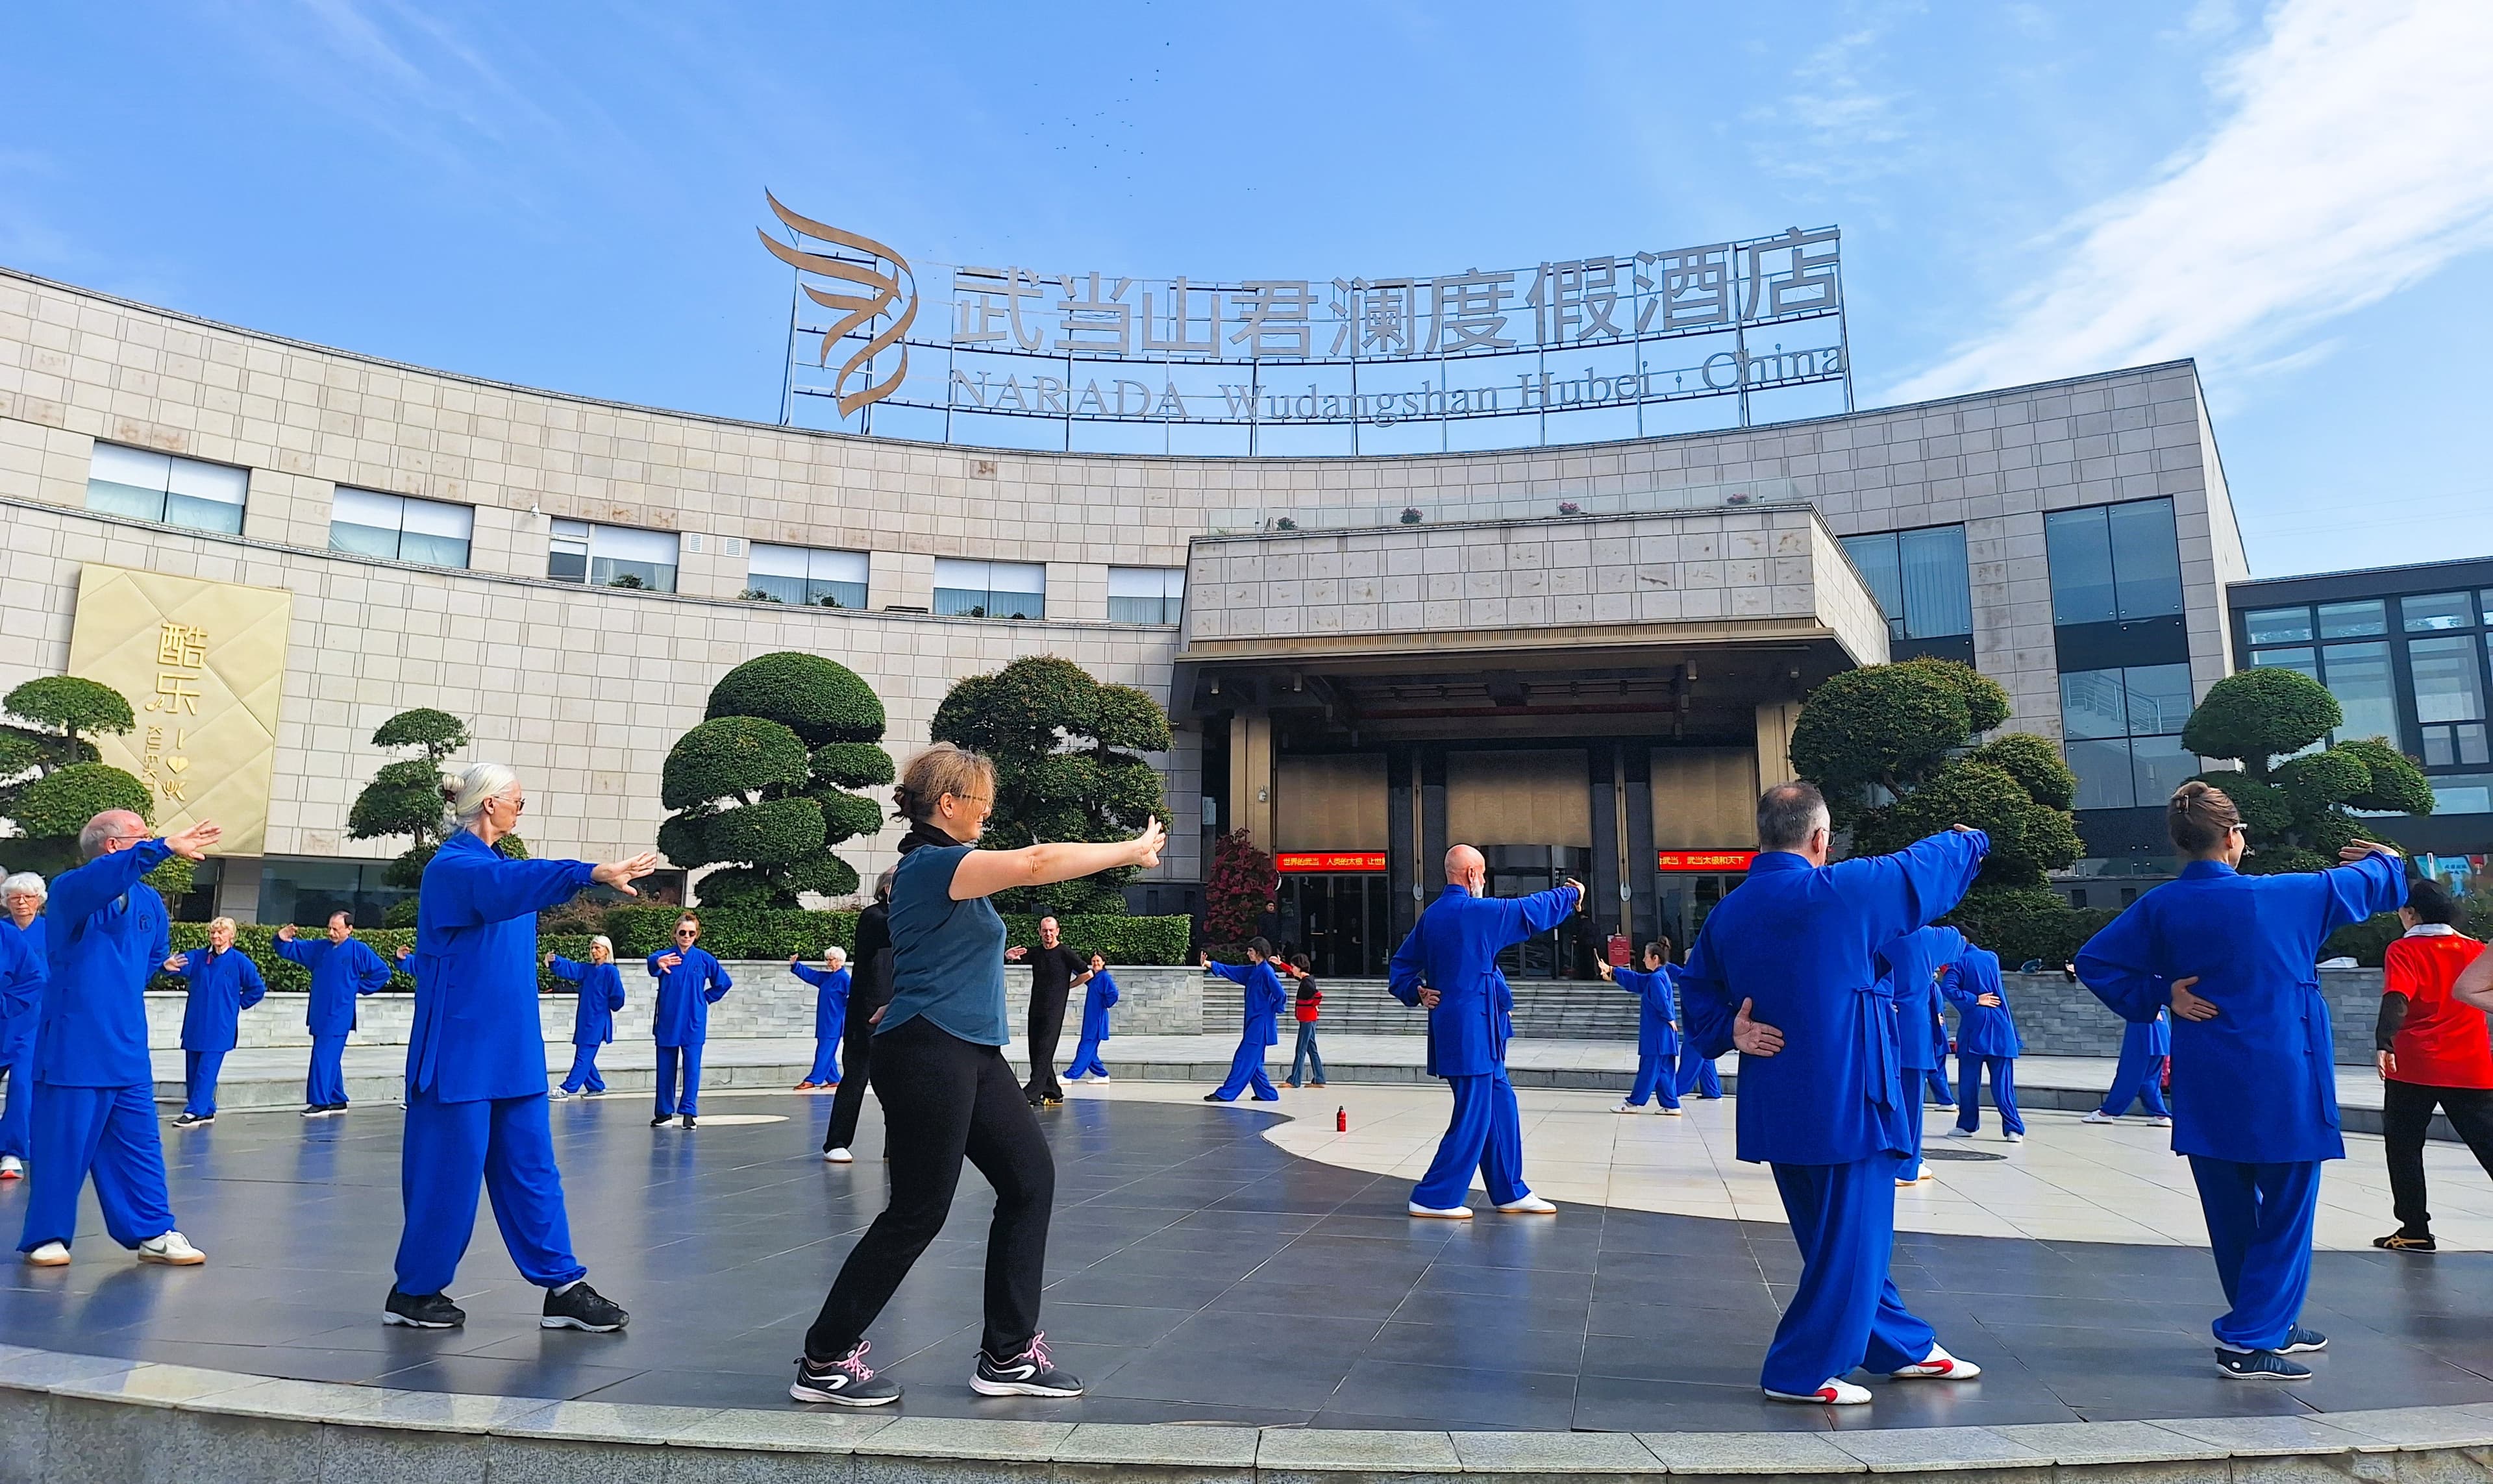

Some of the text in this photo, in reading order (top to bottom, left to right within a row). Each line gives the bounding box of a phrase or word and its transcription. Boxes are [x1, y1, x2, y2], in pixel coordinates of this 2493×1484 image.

[953, 225, 1842, 359] 武当山君澜度假酒店
[950, 368, 1191, 418] NARADA
[1218, 380, 1500, 427] Wudangshan
[1517, 360, 1653, 408] Hubei
[1702, 343, 1847, 390] China
[145, 622, 208, 715] 酷乐
